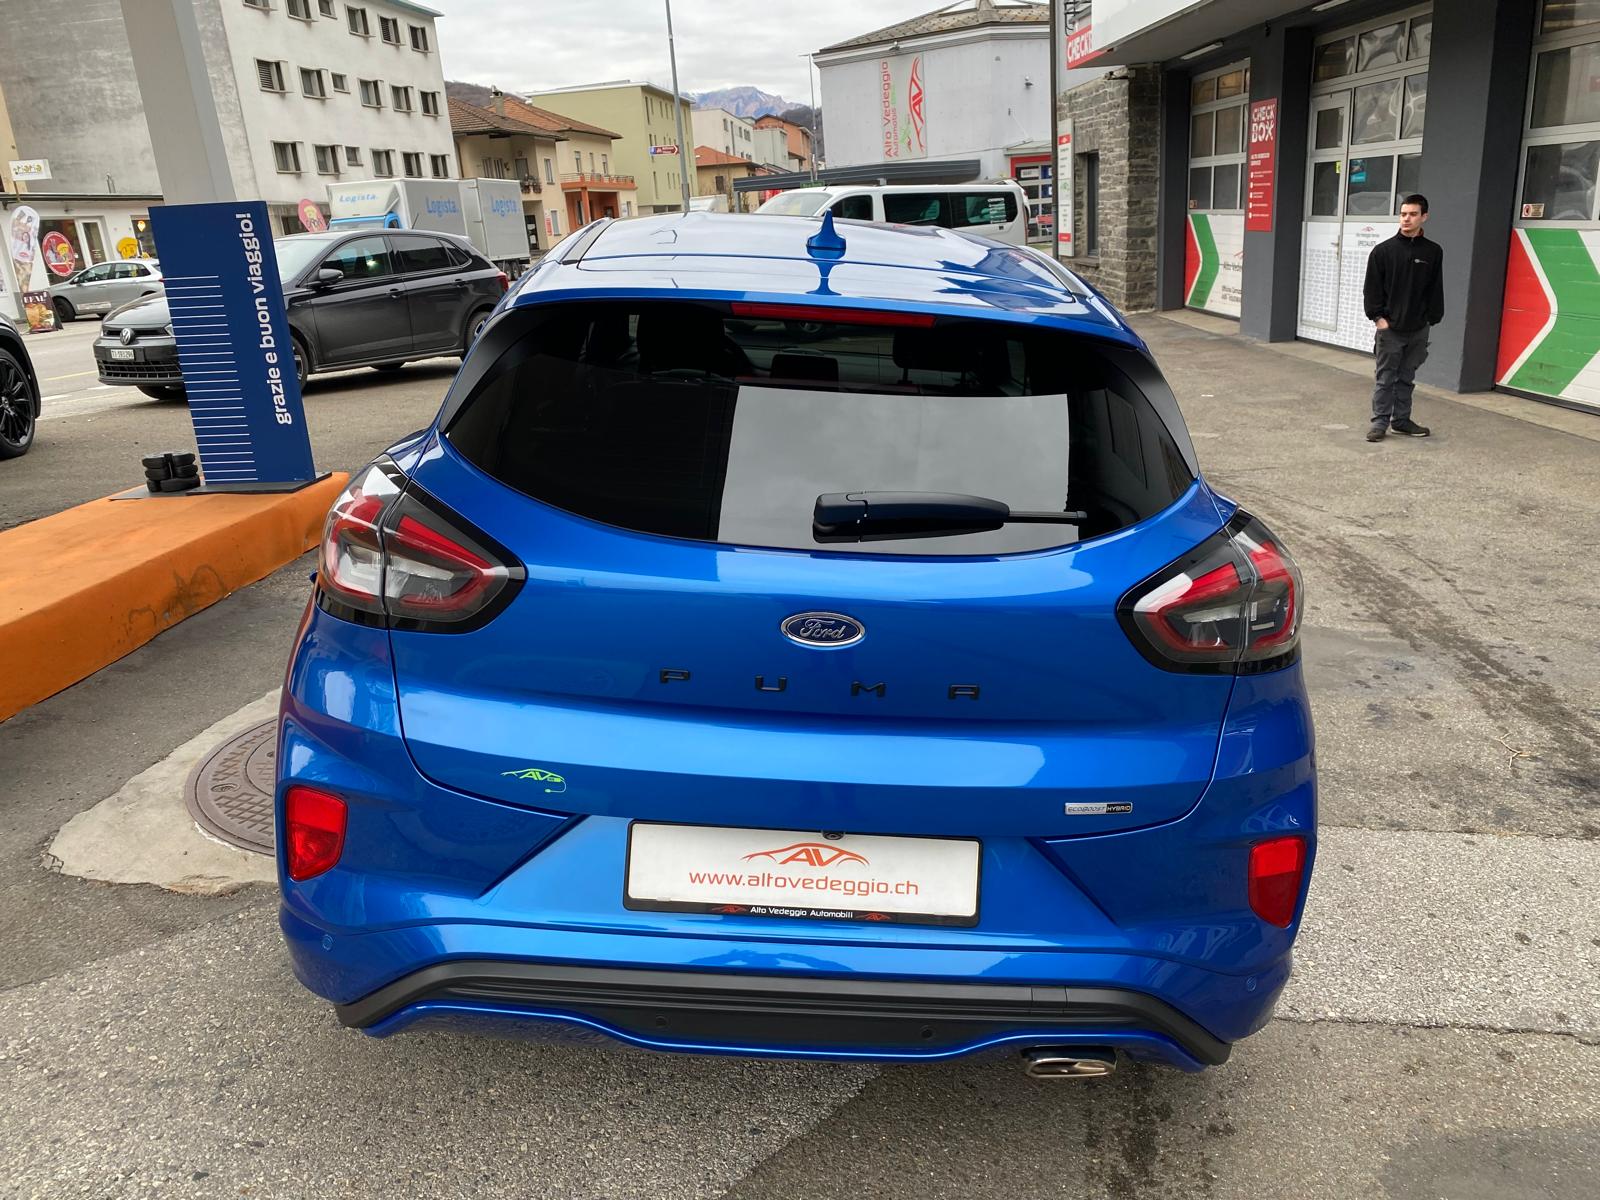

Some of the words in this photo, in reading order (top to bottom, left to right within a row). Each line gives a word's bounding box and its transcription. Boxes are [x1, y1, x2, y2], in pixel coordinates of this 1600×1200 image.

[882, 61, 890, 127] Vedeggio
[1253, 104, 1276, 122] CHECK
[1252, 120, 1274, 142] BOX
[884, 131, 893, 158] Alto
[426, 197, 456, 216] Logista
[236, 212, 265, 294] viaggio!
[255, 297, 275, 348] buon
[265, 352, 278, 363] e
[266, 367, 292, 425] grazie
[800, 618, 845, 640] Ford
[689, 872, 919, 897] www.altovedeggio.ch
[750, 907, 767, 915] Alto
[769, 908, 807, 917] Vedeggio
[810, 910, 853, 919] Automobili
